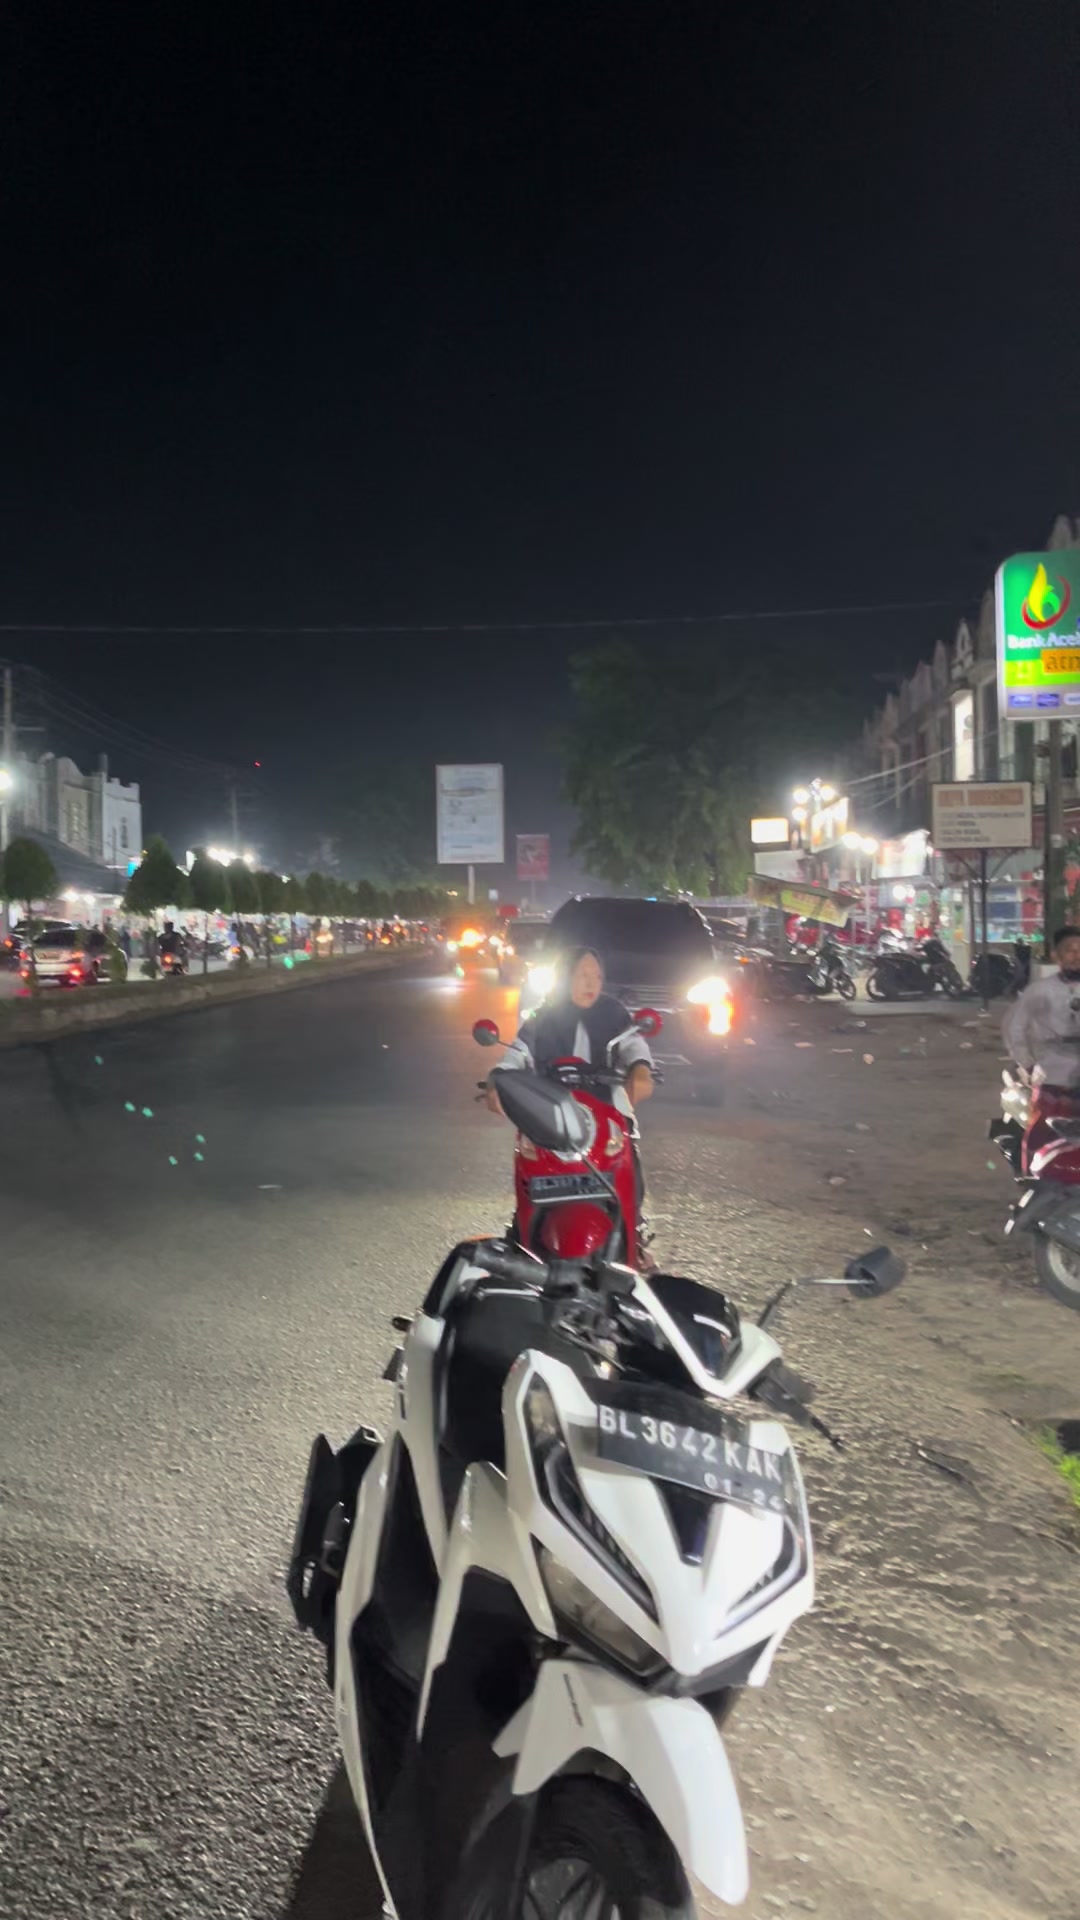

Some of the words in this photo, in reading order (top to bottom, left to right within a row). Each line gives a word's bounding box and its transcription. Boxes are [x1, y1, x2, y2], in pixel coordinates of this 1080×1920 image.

[1007, 633, 1045, 649] Bank
[600, 1404, 637, 1439] BL
[640, 1416, 718, 1464] 3642
[724, 1439, 782, 1484] KAK
